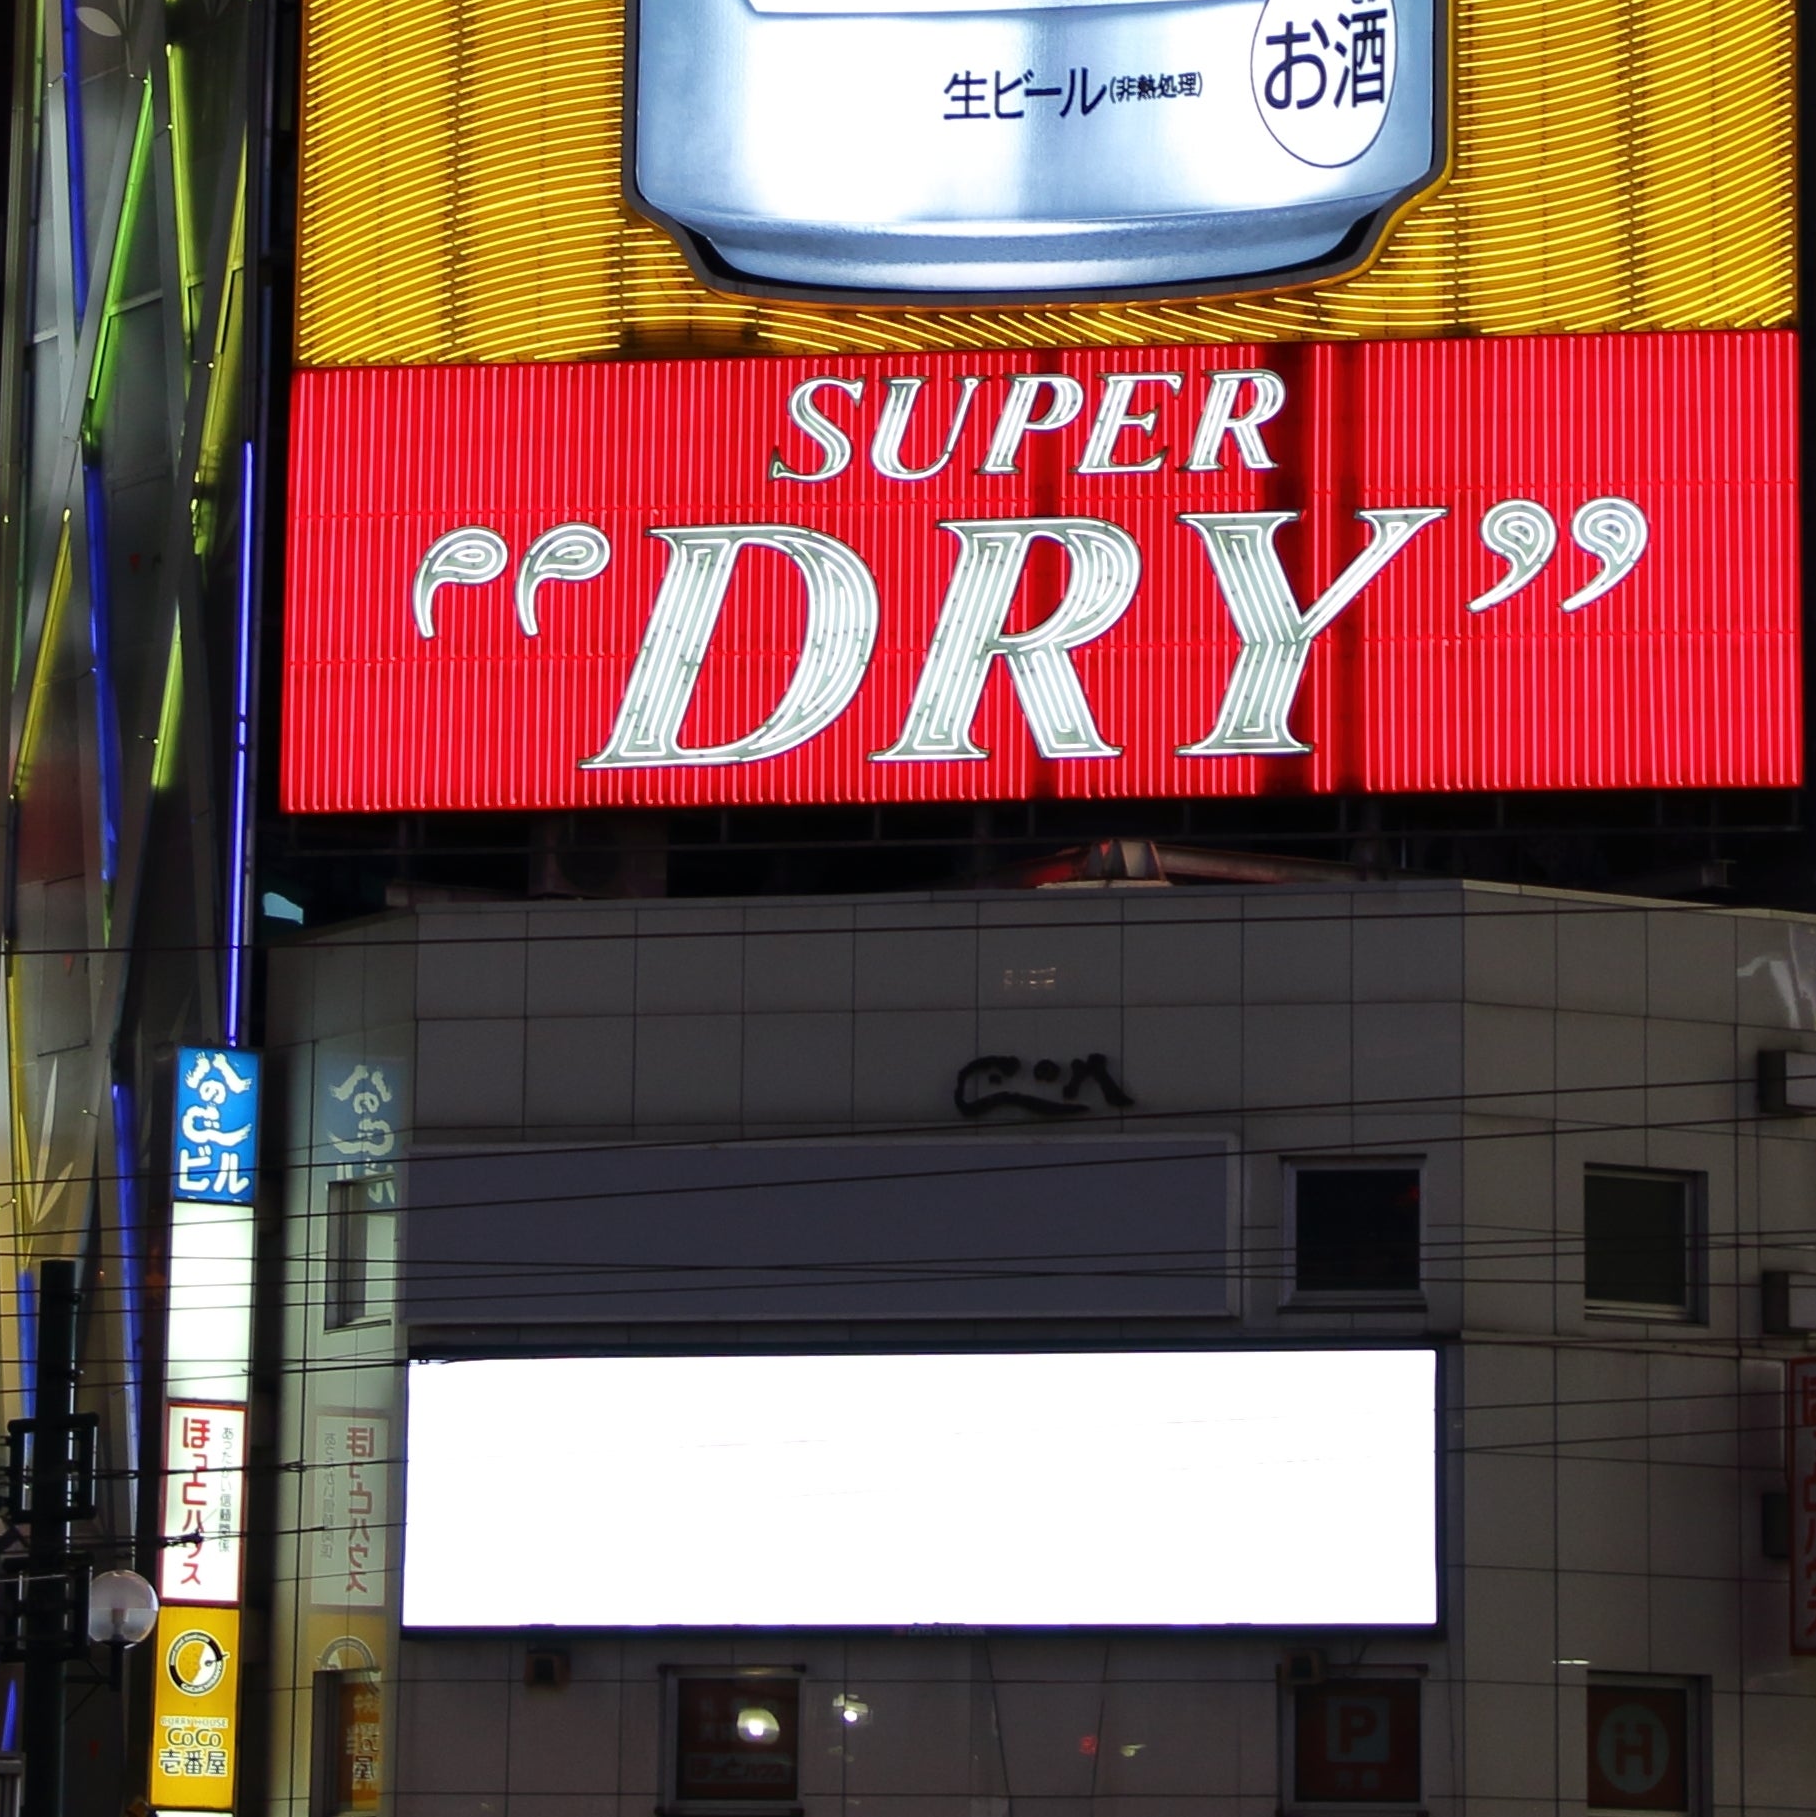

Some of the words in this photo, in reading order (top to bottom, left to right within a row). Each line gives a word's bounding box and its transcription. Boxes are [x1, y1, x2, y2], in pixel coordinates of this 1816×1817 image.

[1264, 8, 1387, 111] お酒
[769, 368, 1287, 482] SUPER
[179, 1144, 250, 1194] ビル
[159, 1748, 227, 1776] 壱番屋
[167, 1727, 222, 1748] CoCo
